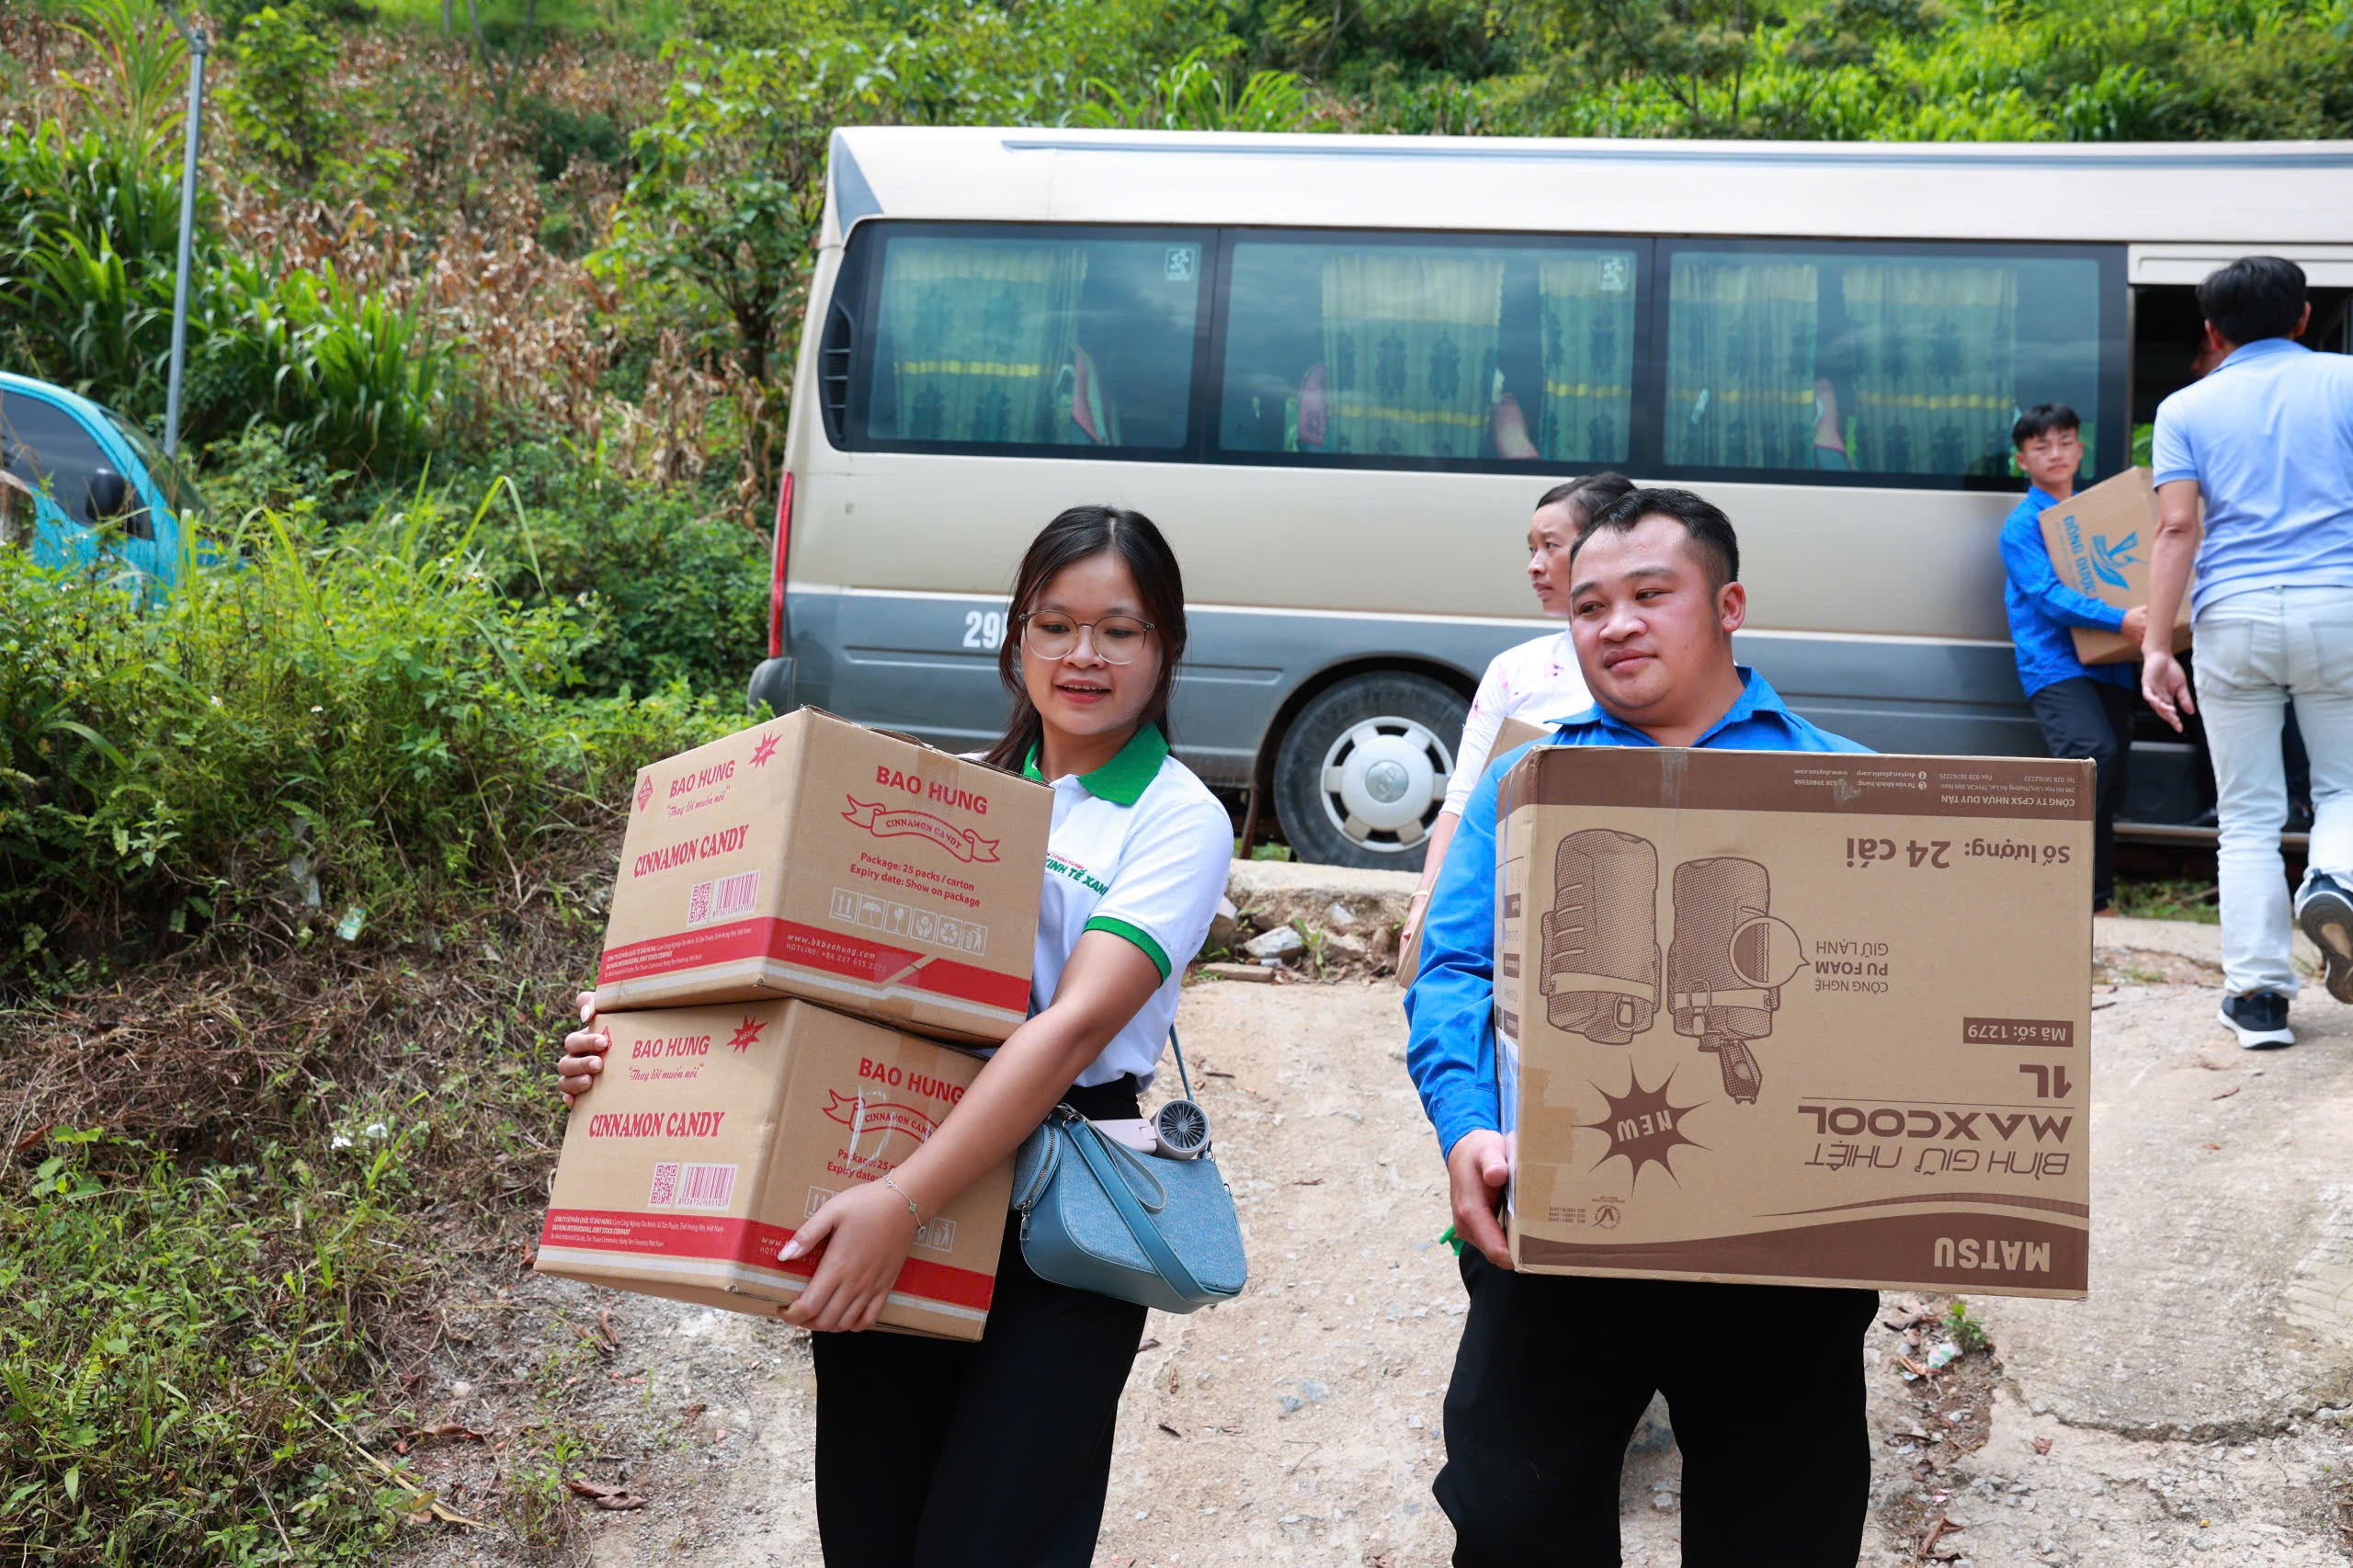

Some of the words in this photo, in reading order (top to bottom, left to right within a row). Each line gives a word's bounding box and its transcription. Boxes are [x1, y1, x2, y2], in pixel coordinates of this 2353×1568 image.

[669, 774, 696, 798] BAO
[698, 759, 735, 789] HUNG
[876, 766, 922, 794] BAO
[928, 781, 988, 814] HUNG
[1961, 795, 1981, 803] DUY
[2011, 797, 2034, 806] CPSX
[2036, 798, 2048, 806] TY
[2049, 798, 2075, 807] CÔNG
[885, 819, 932, 833] CINNAMON
[934, 827, 962, 849] CANDY
[634, 838, 699, 878] CINNAMON
[699, 824, 749, 859] CANDY
[1846, 837, 1896, 869] cái
[1906, 839, 1951, 869] 24
[1964, 838, 2037, 863] lượng:
[2042, 845, 2070, 866] Số
[860, 852, 901, 870] Package:
[903, 864, 913, 873] 25
[915, 868, 940, 883] packs
[947, 878, 974, 892] carton
[850, 864, 880, 881] Expiry
[881, 871, 904, 885] date:
[905, 880, 929, 892] Show
[931, 887, 943, 896] on
[944, 890, 981, 907] package
[786, 943, 819, 957] HOTLINE:
[787, 934, 876, 959] www.bkbaohung.com
[1816, 938, 1857, 955] LẠNH
[1860, 942, 1889, 958] GIỮ
[1815, 960, 1862, 975] FOAM
[1867, 962, 1888, 976] PU
[1815, 977, 1849, 992] NGHỆ
[1853, 981, 1889, 994] CÔNG
[1968, 1024, 2008, 1040] 1279
[2013, 1026, 2037, 1042] số:
[2041, 1027, 2066, 1041] Mã
[632, 1039, 663, 1059] BAO
[665, 1035, 711, 1057] HUNG
[662, 1066, 682, 1079] muốn
[858, 1057, 903, 1086] BAO
[907, 1073, 967, 1105] HUNG
[2019, 1063, 2073, 1098] 1L
[588, 1112, 665, 1138] CINNAMON
[665, 1111, 725, 1138] CANDY
[1617, 1109, 1674, 1142] NEW
[1798, 1105, 2073, 1143] MAXCOOL
[877, 1159, 889, 1171] 25
[1804, 1140, 1903, 1172] NHIỆT
[1915, 1147, 1980, 1176] GIỮ
[1987, 1149, 2070, 1181] BÌNH
[1934, 1236, 2051, 1273] MATSU
